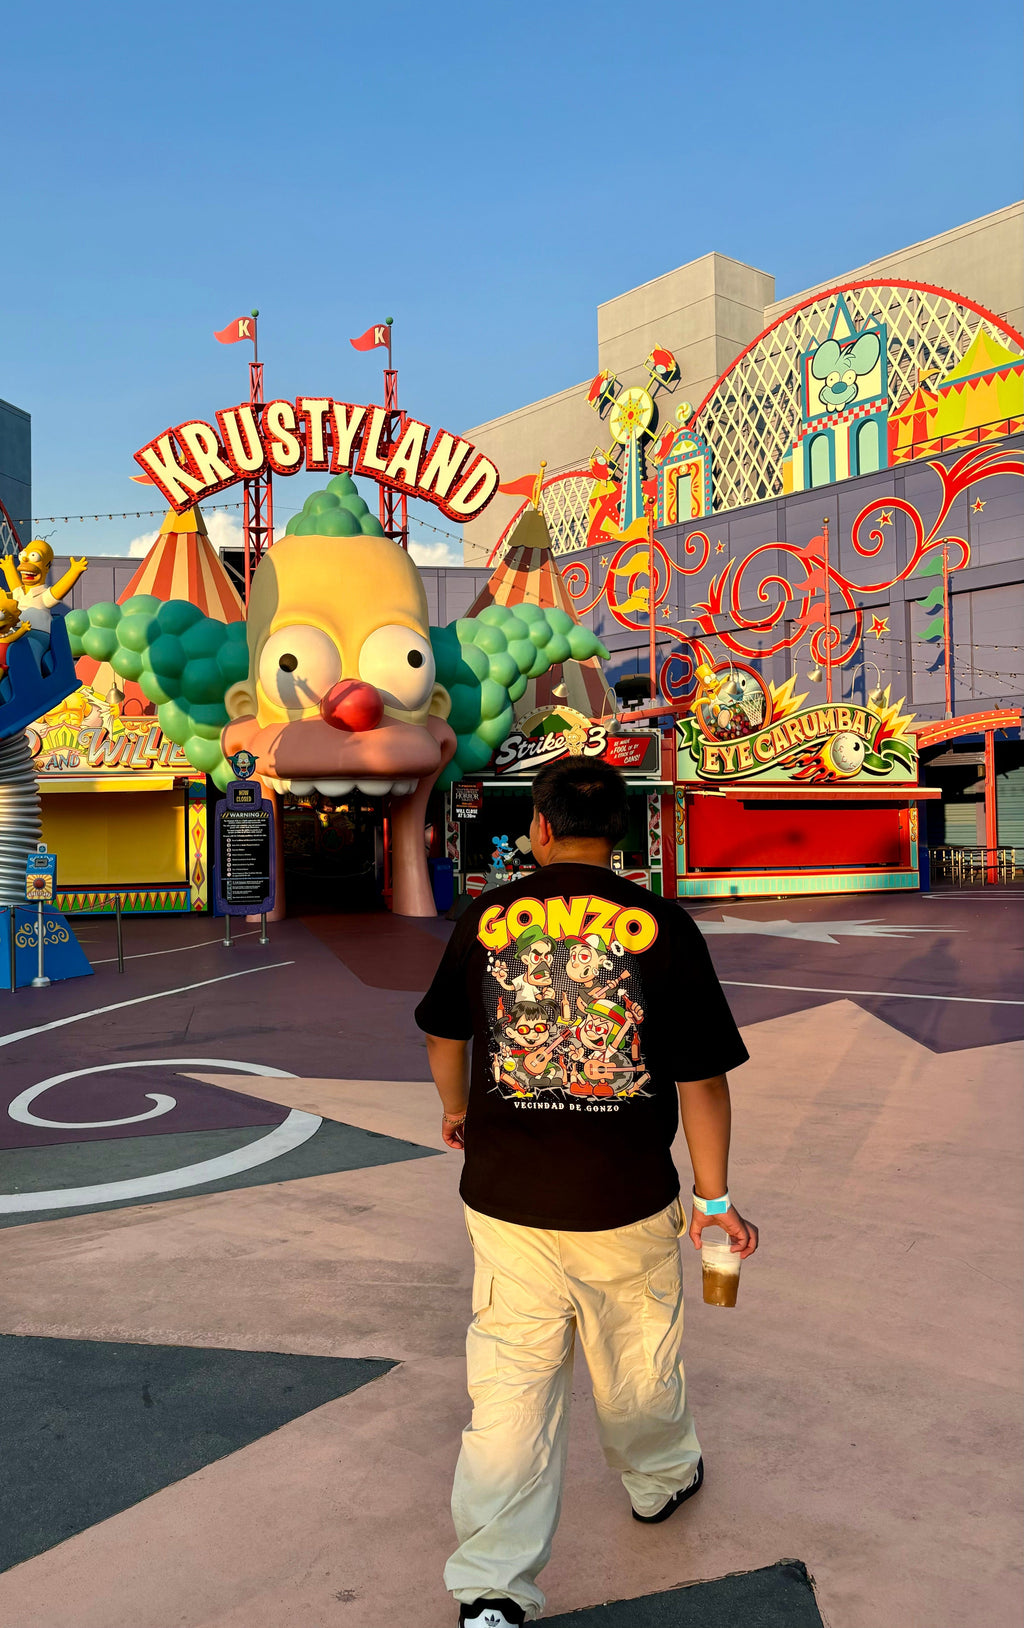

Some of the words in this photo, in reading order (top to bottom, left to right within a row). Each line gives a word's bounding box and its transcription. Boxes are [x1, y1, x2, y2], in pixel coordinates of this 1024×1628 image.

[238, 319, 251, 338] K
[374, 327, 386, 345] K
[137, 398, 499, 518] KRUSTYLAND
[495, 731, 568, 765] Strike
[583, 726, 606, 757] 3
[613, 745, 627, 754] FOOL
[702, 740, 754, 773] EYE
[753, 708, 880, 763] CARUMBA!
[45, 750, 80, 770] AND
[623, 754, 641, 764] CANS!
[477, 895, 659, 955] GONZO
[513, 1101, 565, 1110] VECINDAD
[569, 1103, 582, 1111] DE
